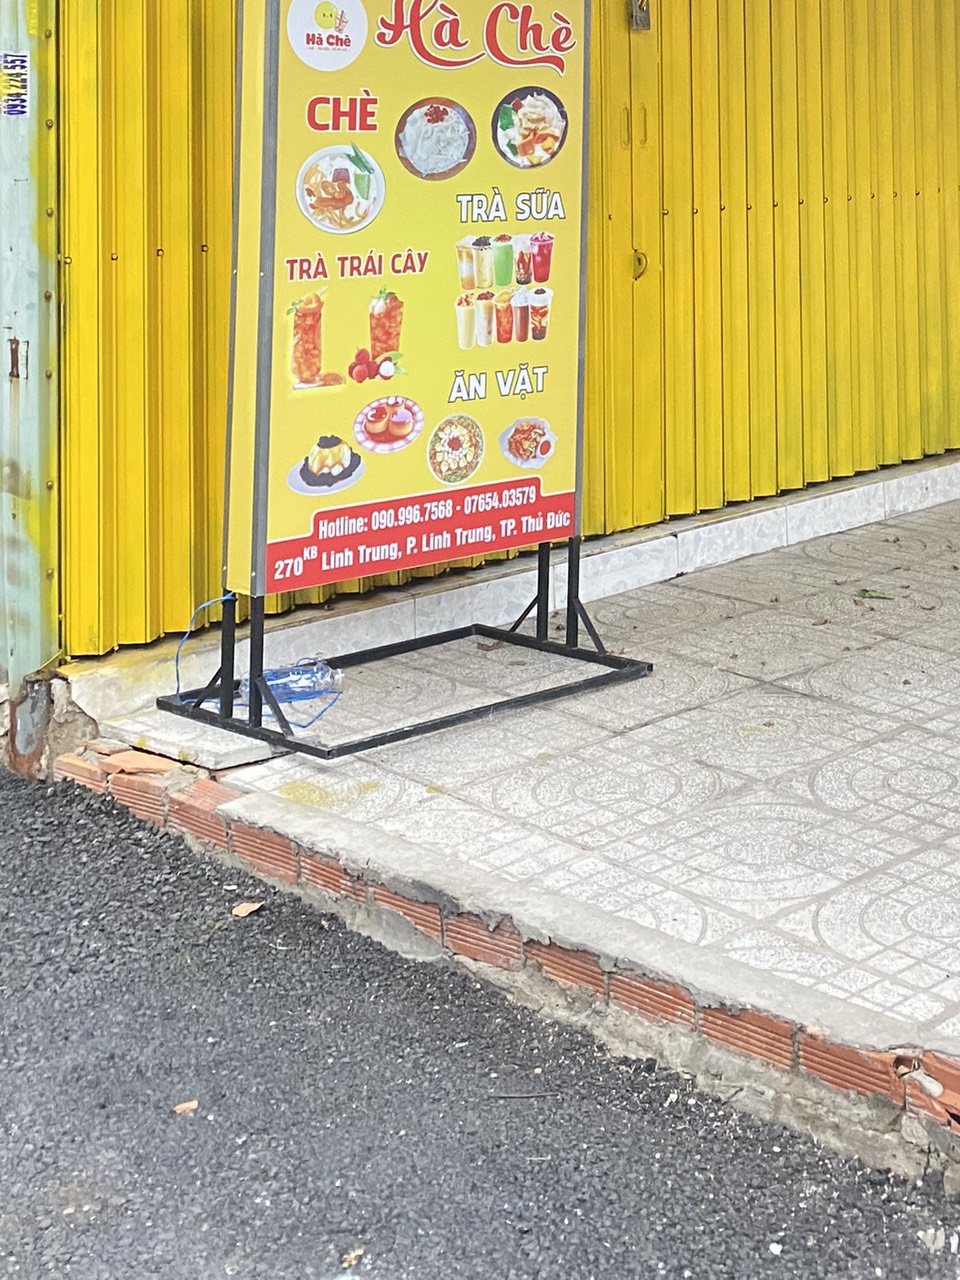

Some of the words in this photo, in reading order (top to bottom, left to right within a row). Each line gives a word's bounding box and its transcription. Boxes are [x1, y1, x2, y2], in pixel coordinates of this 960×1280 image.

[305, 33, 323, 46] Hà
[326, 34, 352, 48] Chè
[482, 2, 577, 77] Chè
[306, 89, 379, 133] CHÈ
[456, 187, 507, 224] TRÀ
[515, 187, 566, 222] SỮA
[285, 251, 329, 283] TRÀ
[337, 249, 383, 279] TRÁI
[390, 248, 430, 275] CÂY
[447, 369, 487, 404] ĂN
[495, 363, 548, 401] VẶT
[318, 516, 368, 540] Hotline:
[371, 499, 453, 531] 090.996.7568
[463, 485, 536, 515] 07654.03579
[321, 548, 353, 571] Linh
[358, 543, 403, 564] Trung,
[406, 536, 418, 556] P.
[421, 531, 451, 552] Linh
[455, 525, 496, 546] Trung,
[500, 519, 518, 538] TP.
[520, 511, 543, 534] Thủ
[547, 509, 571, 530] Đức
